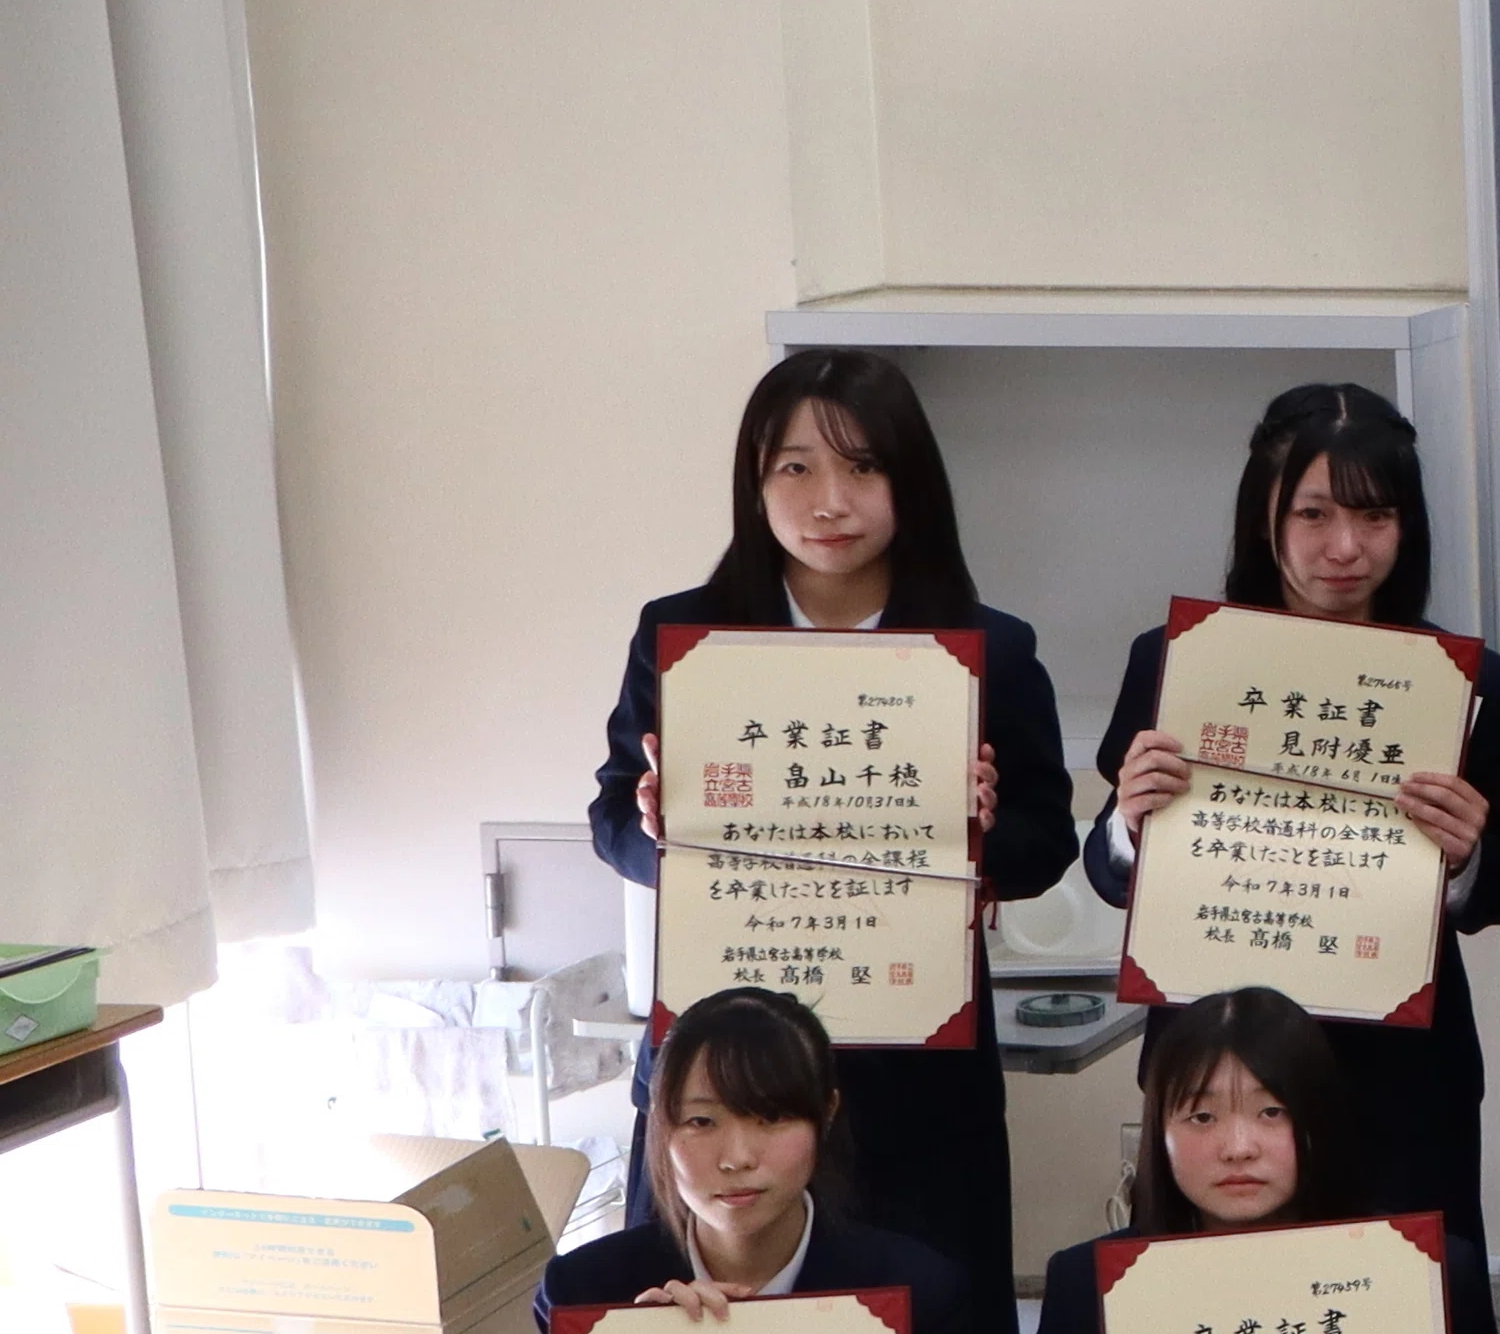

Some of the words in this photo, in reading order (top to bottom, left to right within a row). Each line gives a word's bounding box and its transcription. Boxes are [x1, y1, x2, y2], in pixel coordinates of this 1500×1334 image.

[1238, 687, 1384, 727] 卒業証書
[738, 721, 889, 749] 卒業証書
[1278, 731, 1405, 766] 見附優亜
[723, 822, 935, 841] あなたは本校において
[1191, 839, 1390, 869] を卒業したことを証します
[708, 878, 914, 899] を卒業したことを証します
[1221, 877, 1349, 898] 令和7年3月1日
[745, 916, 877, 930] 令和7年3月1日
